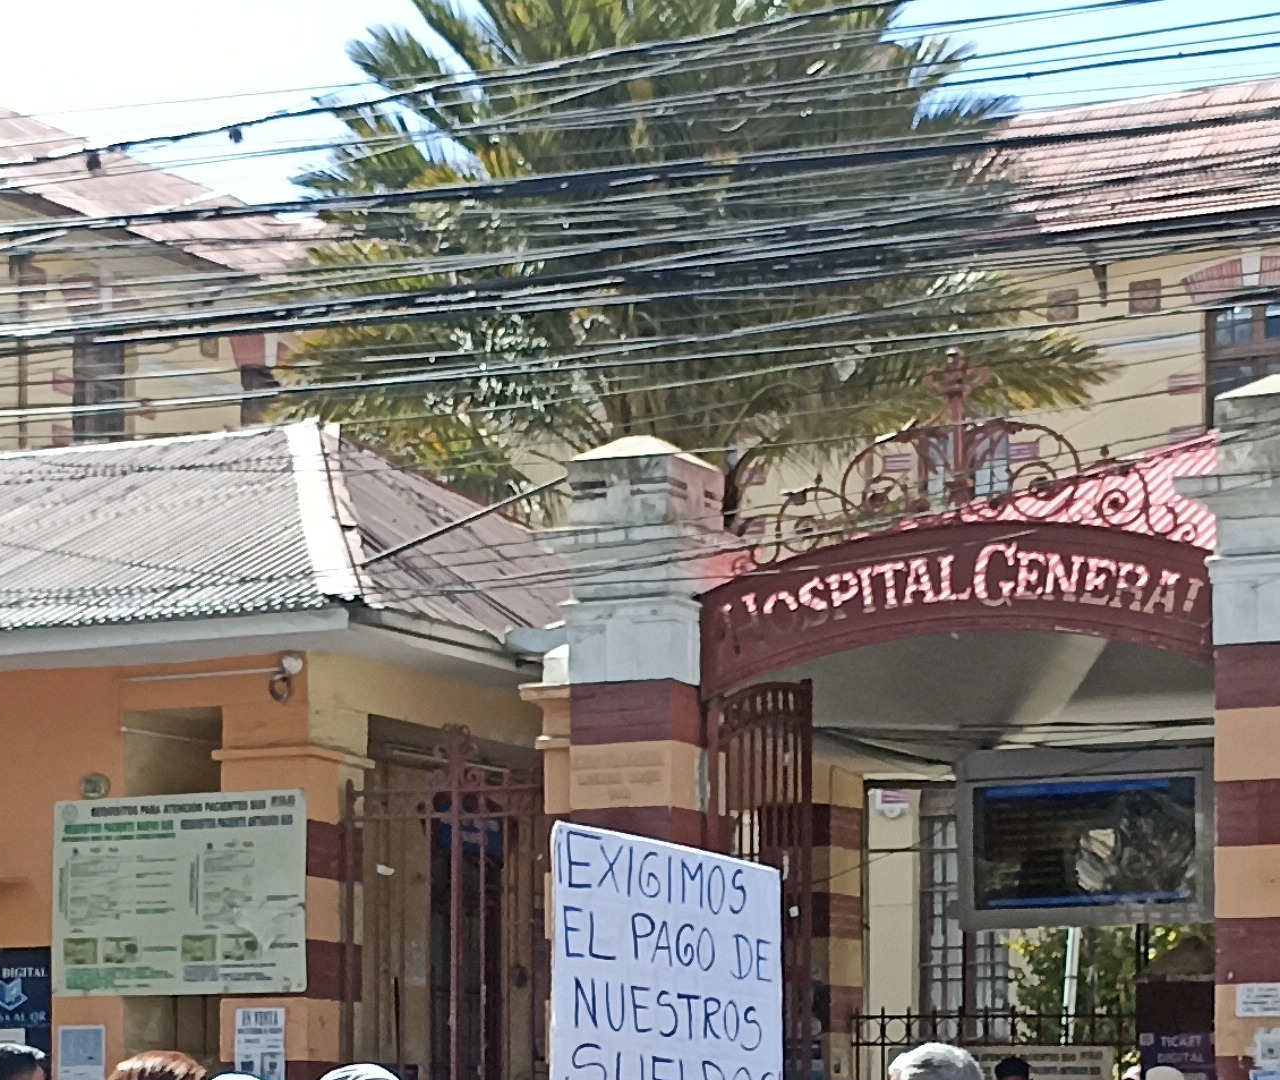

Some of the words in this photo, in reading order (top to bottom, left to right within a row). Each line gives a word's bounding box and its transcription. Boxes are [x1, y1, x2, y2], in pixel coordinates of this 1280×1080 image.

[717, 553, 971, 640] HOSPITAL
[972, 541, 1212, 628] GENERAL
[2, 967, 48, 979] DIGITAL
[563, 905, 617, 961] EL
[631, 911, 716, 972] PAGO
[730, 933, 773, 982] DE
[573, 976, 764, 1051] NUESTROS
